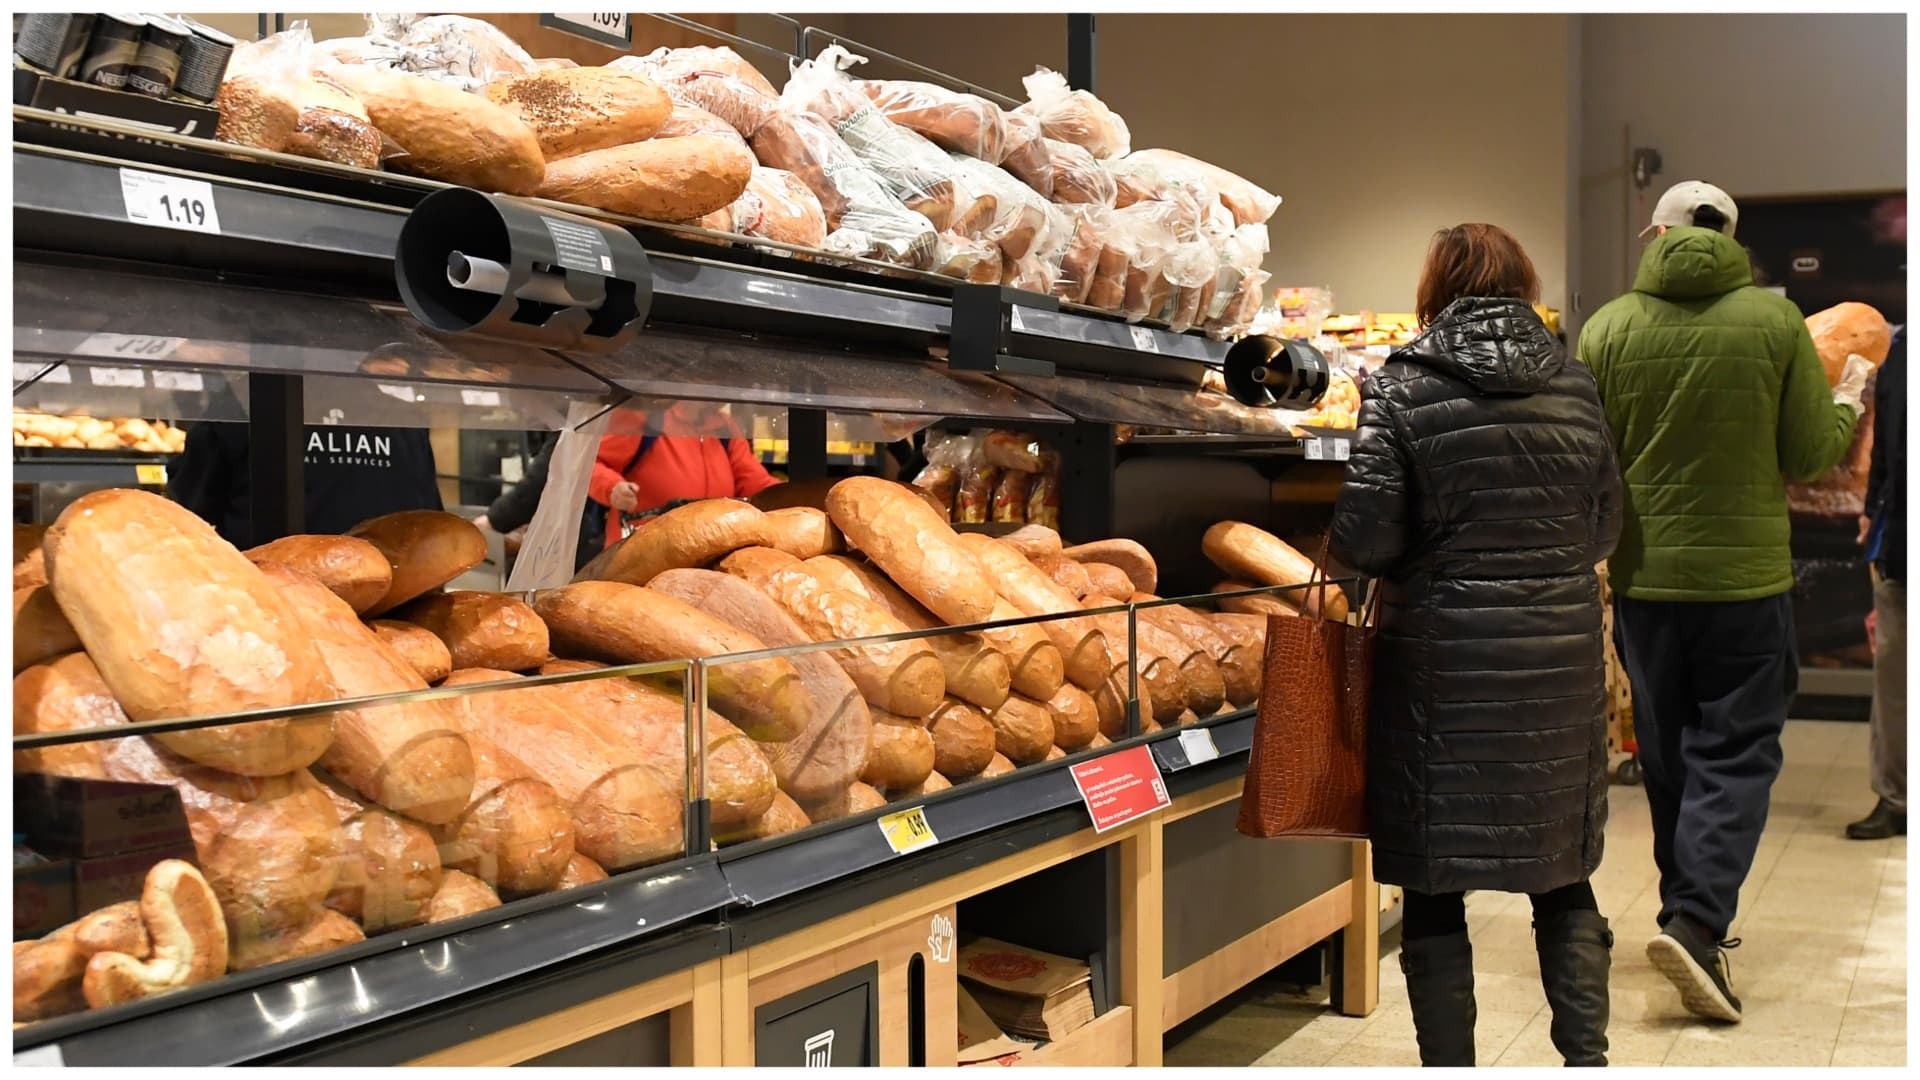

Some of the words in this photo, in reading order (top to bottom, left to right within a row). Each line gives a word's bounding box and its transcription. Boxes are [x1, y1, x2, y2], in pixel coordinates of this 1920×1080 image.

[160, 194, 205, 226] 1.19
[307, 431, 390, 456] ALIAN
[329, 455, 391, 468] SERVICES
[906, 813, 928, 837] 0.99
